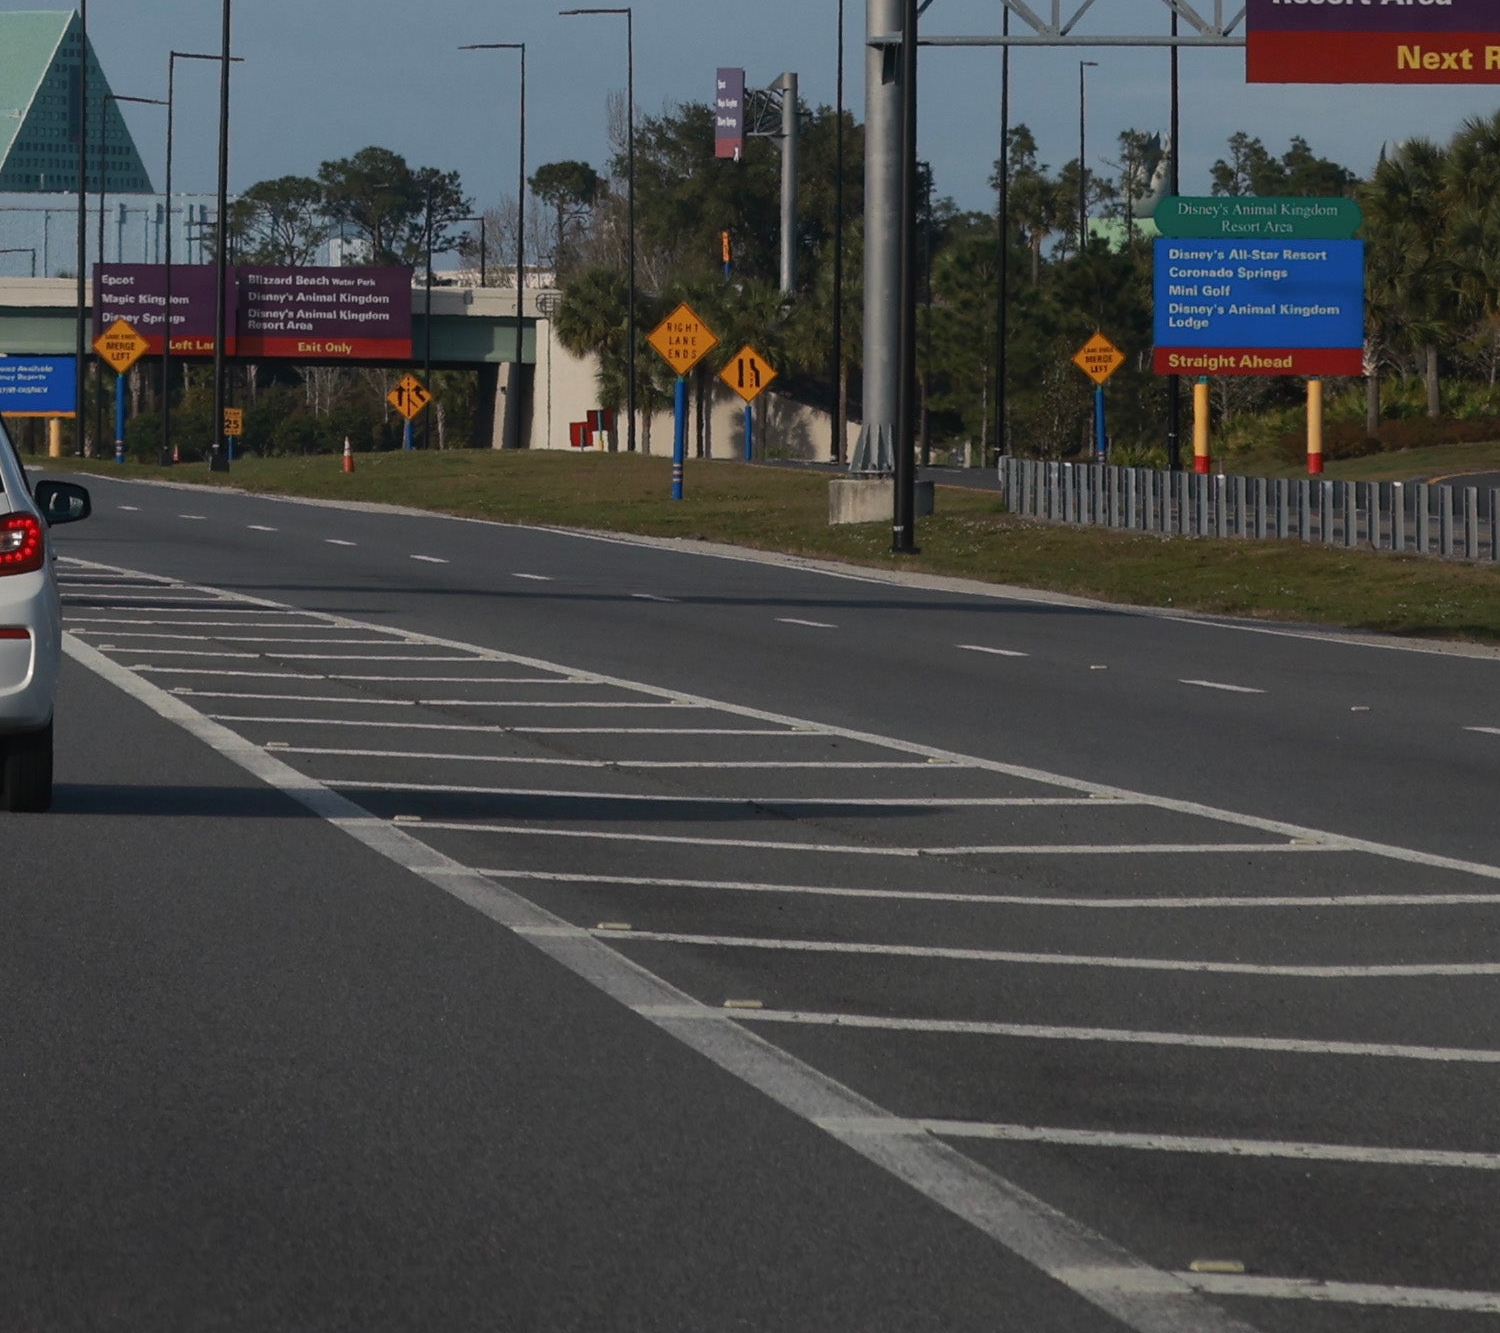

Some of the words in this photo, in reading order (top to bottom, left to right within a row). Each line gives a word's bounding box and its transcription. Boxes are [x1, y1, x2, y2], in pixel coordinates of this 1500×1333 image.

[1397, 45, 1473, 70] Next
[1178, 203, 1229, 219] Disney's
[1232, 203, 1277, 215] Animal
[1281, 204, 1338, 218] Kingdom
[1222, 220, 1260, 232] Resort
[1264, 221, 1293, 233] Area
[1168, 248, 1225, 261] Disney's
[1229, 249, 1279, 260] All-Star
[1283, 250, 1327, 261] Resort
[102, 274, 134, 285] Epcot
[1169, 267, 1234, 278] Coronado
[1237, 267, 1288, 280] Springs
[248, 274, 292, 285] Blizzard
[296, 275, 329, 286] Beach
[1169, 285, 1197, 296] Mini
[1202, 285, 1231, 296] Golf
[102, 293, 135, 305] Magic
[248, 291, 293, 303] Disney's
[296, 292, 336, 303] Animal
[340, 294, 389, 305] Kingdom
[248, 308, 293, 320] Disney's
[296, 309, 337, 320] Animal
[340, 310, 389, 322] Kingdom
[1168, 303, 1224, 316] Disney's
[1228, 304, 1276, 314] Animal
[1280, 304, 1340, 317] Kingdom
[248, 320, 284, 330] Resort
[287, 321, 313, 330] Area
[667, 323, 699, 332] RIGHT
[1169, 317, 1209, 329] Lodge
[169, 340, 192, 350] Left
[669, 336, 696, 346] LANE
[298, 342, 321, 352] Exit
[325, 342, 352, 354] Only
[668, 349, 697, 359] ENDS
[1168, 354, 1235, 370] Straight
[1239, 355, 1293, 368] Ahead
